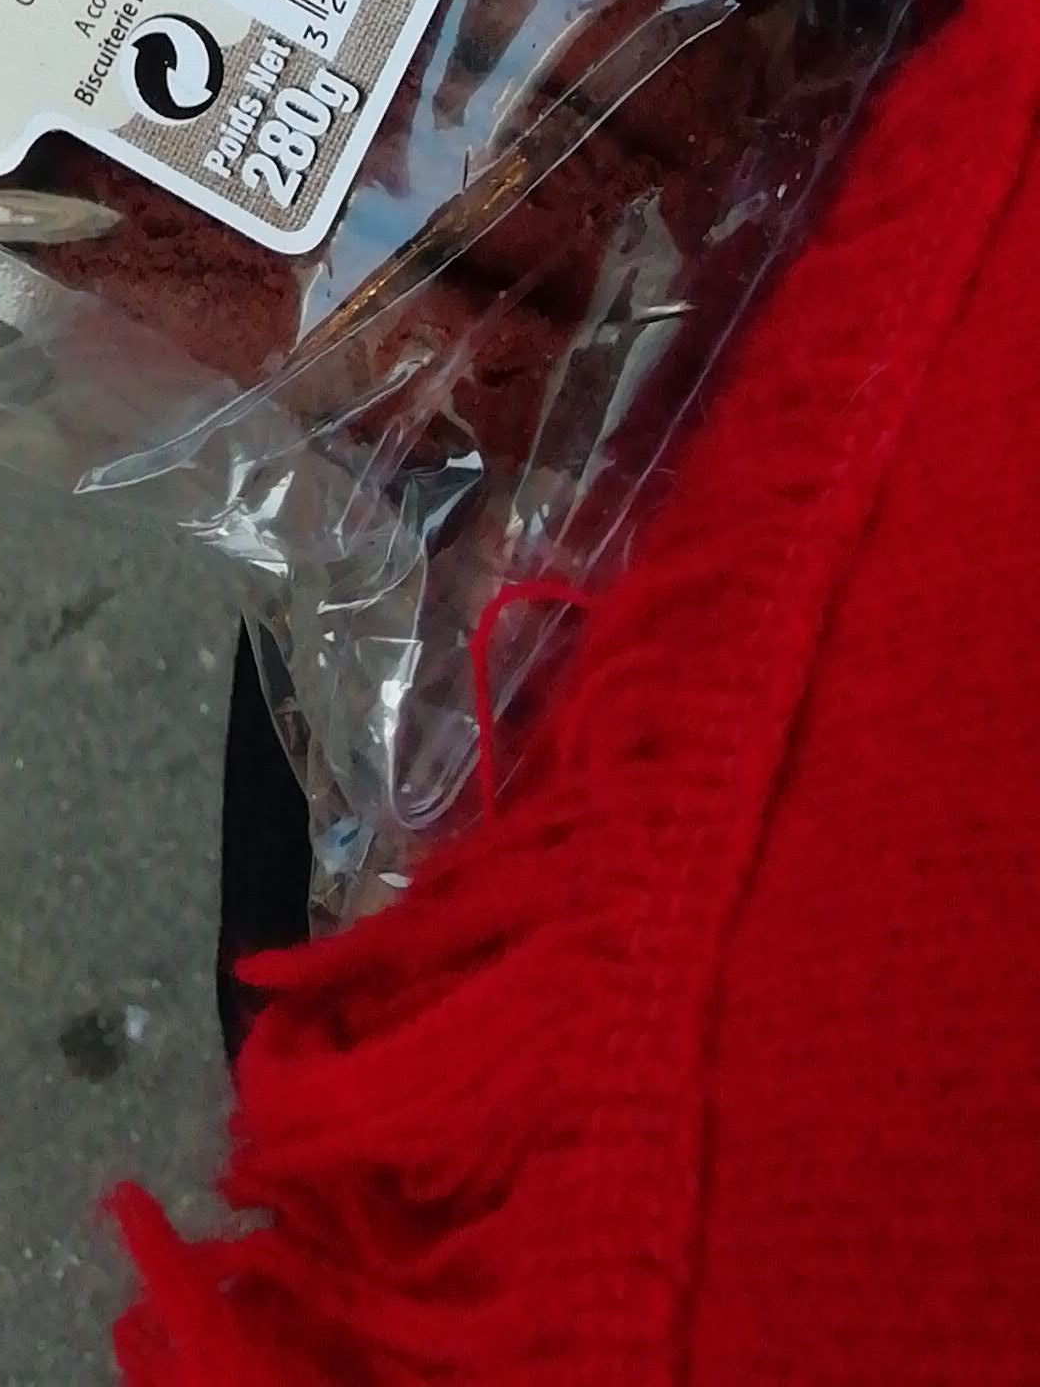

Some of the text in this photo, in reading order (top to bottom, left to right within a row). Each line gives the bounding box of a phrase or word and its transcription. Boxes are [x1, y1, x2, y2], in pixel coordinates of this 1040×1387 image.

[72, 0, 139, 108] Biscuiterie
[200, 33, 293, 180] Poids Net
[244, 65, 359, 209] 280g
